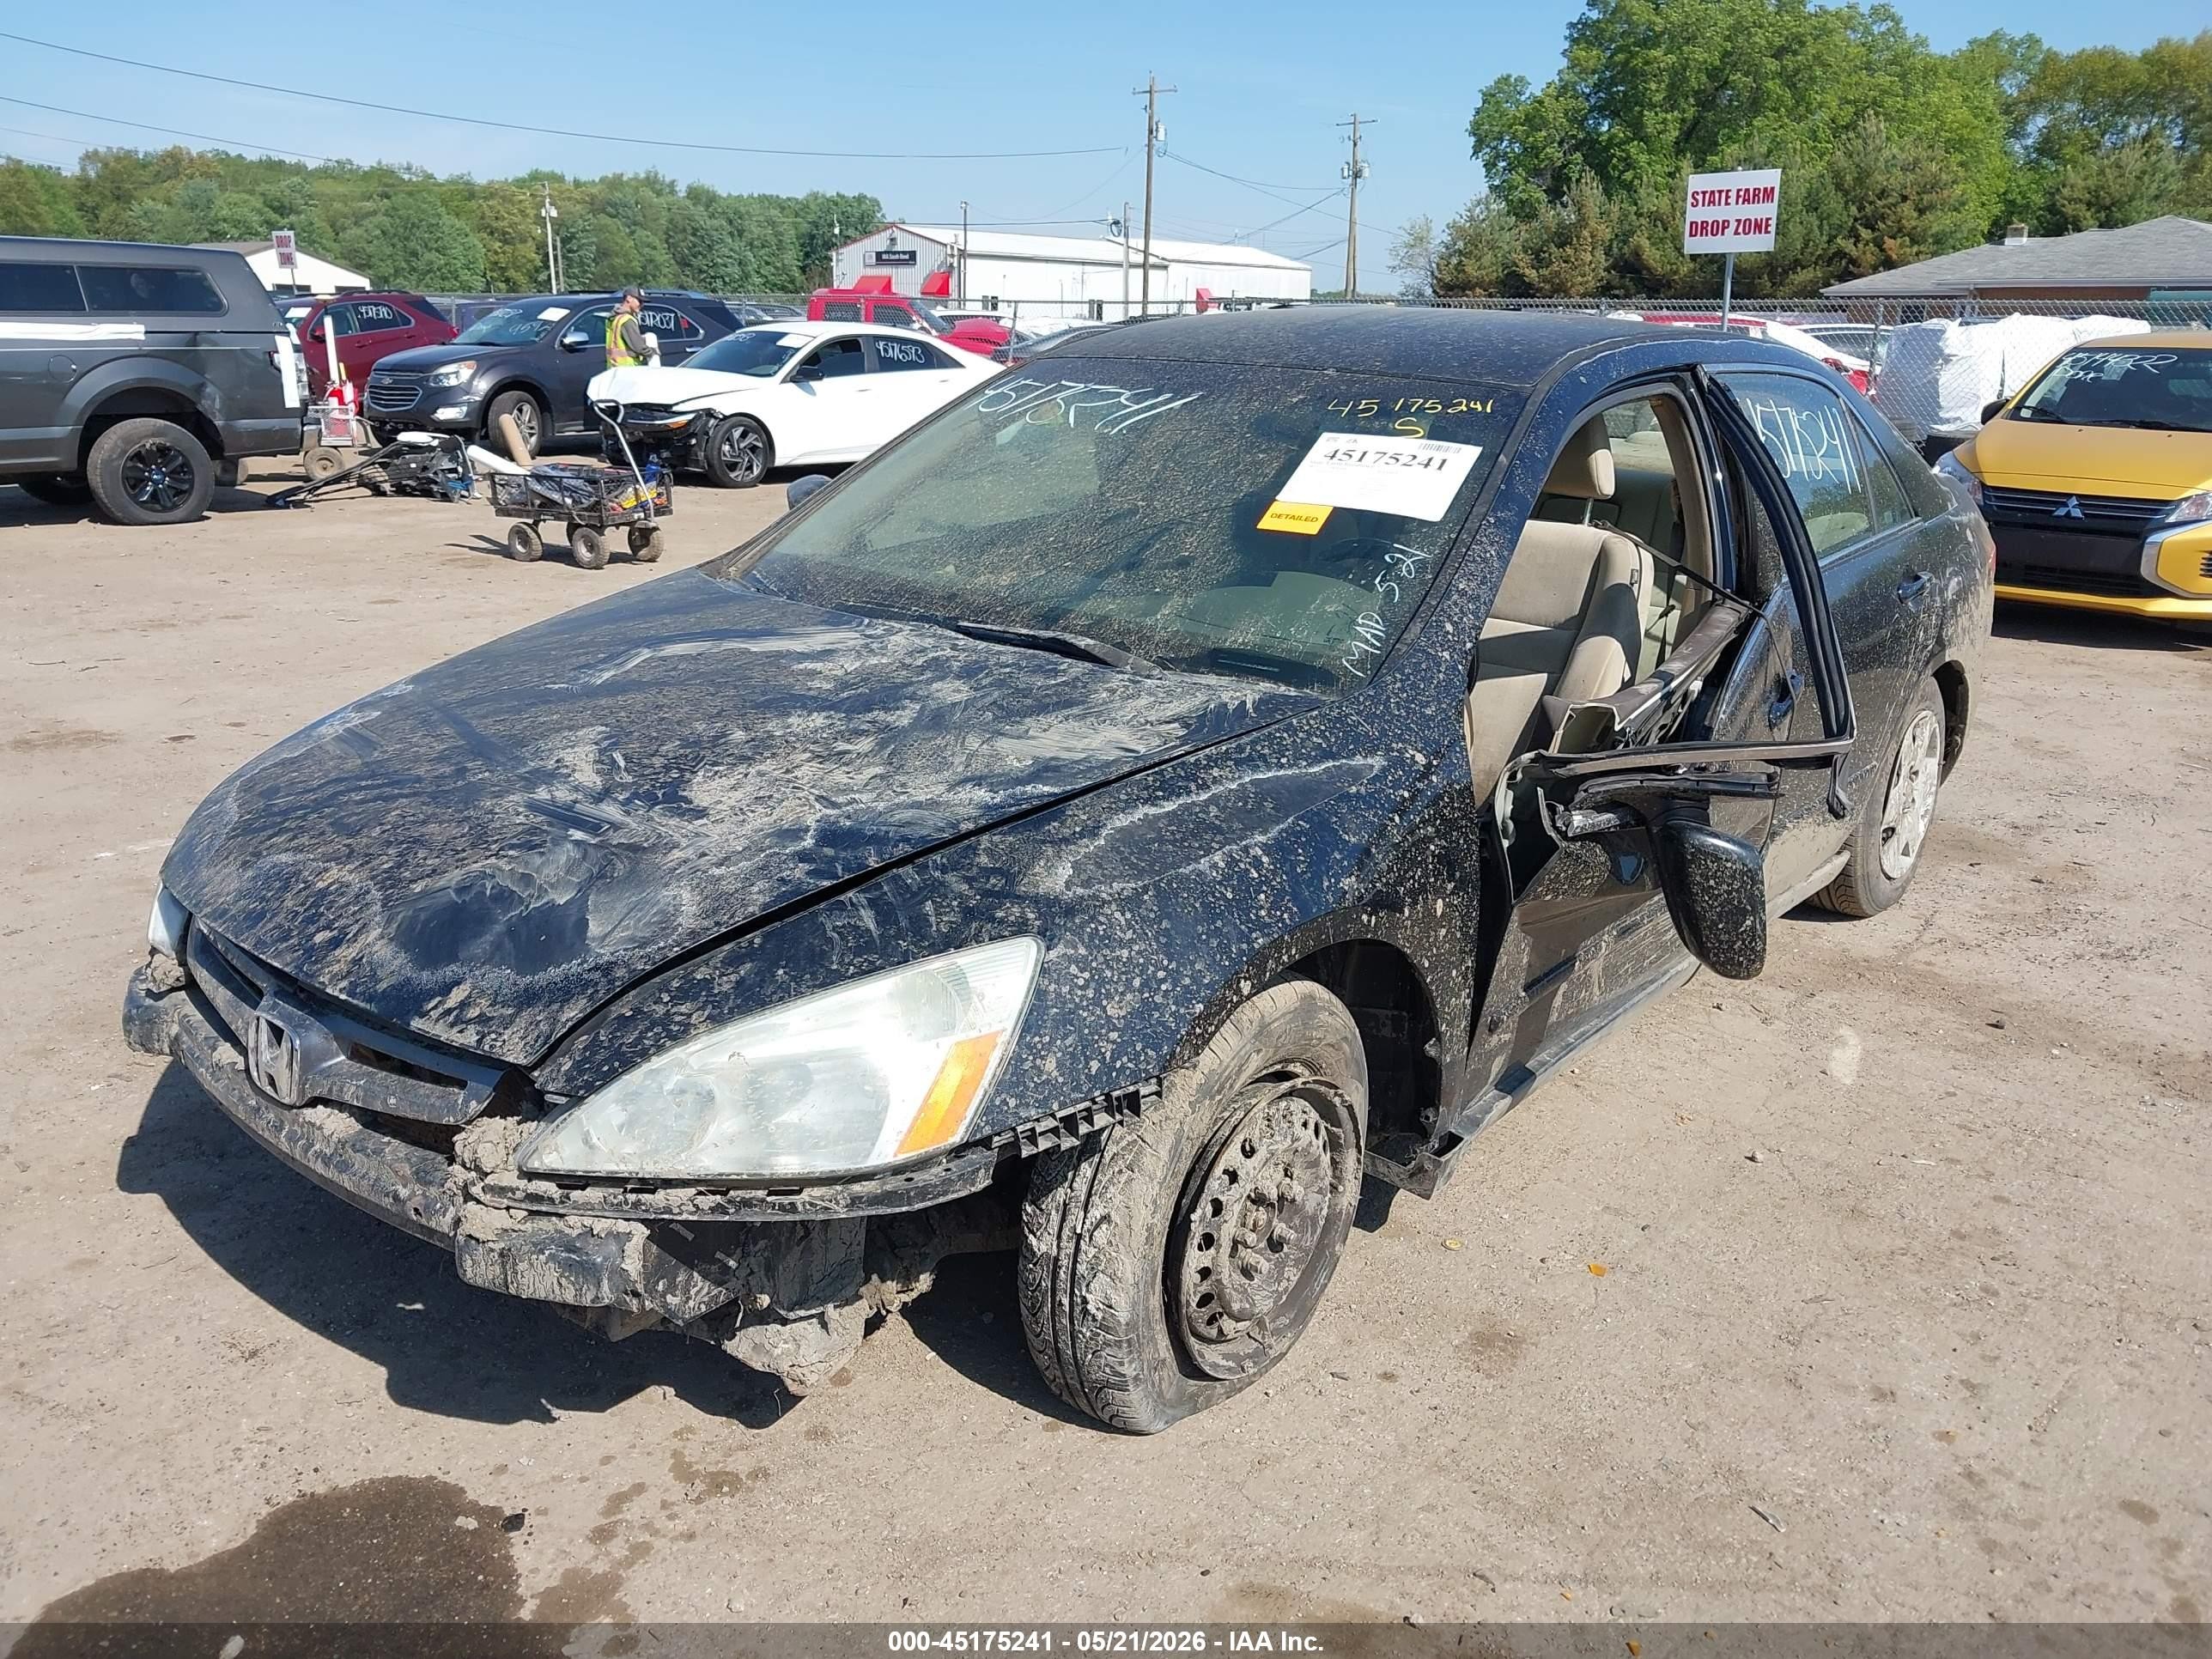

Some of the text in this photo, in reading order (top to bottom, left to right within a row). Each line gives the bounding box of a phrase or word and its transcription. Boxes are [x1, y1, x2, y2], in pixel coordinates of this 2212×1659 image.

[1691, 186, 1776, 208] STATE FARM
[1688, 217, 1773, 238] DROP ZONE
[1394, 416, 1425, 439] S
[1323, 447, 1449, 471] 45175241
[1270, 512, 1318, 523] DETAILED
